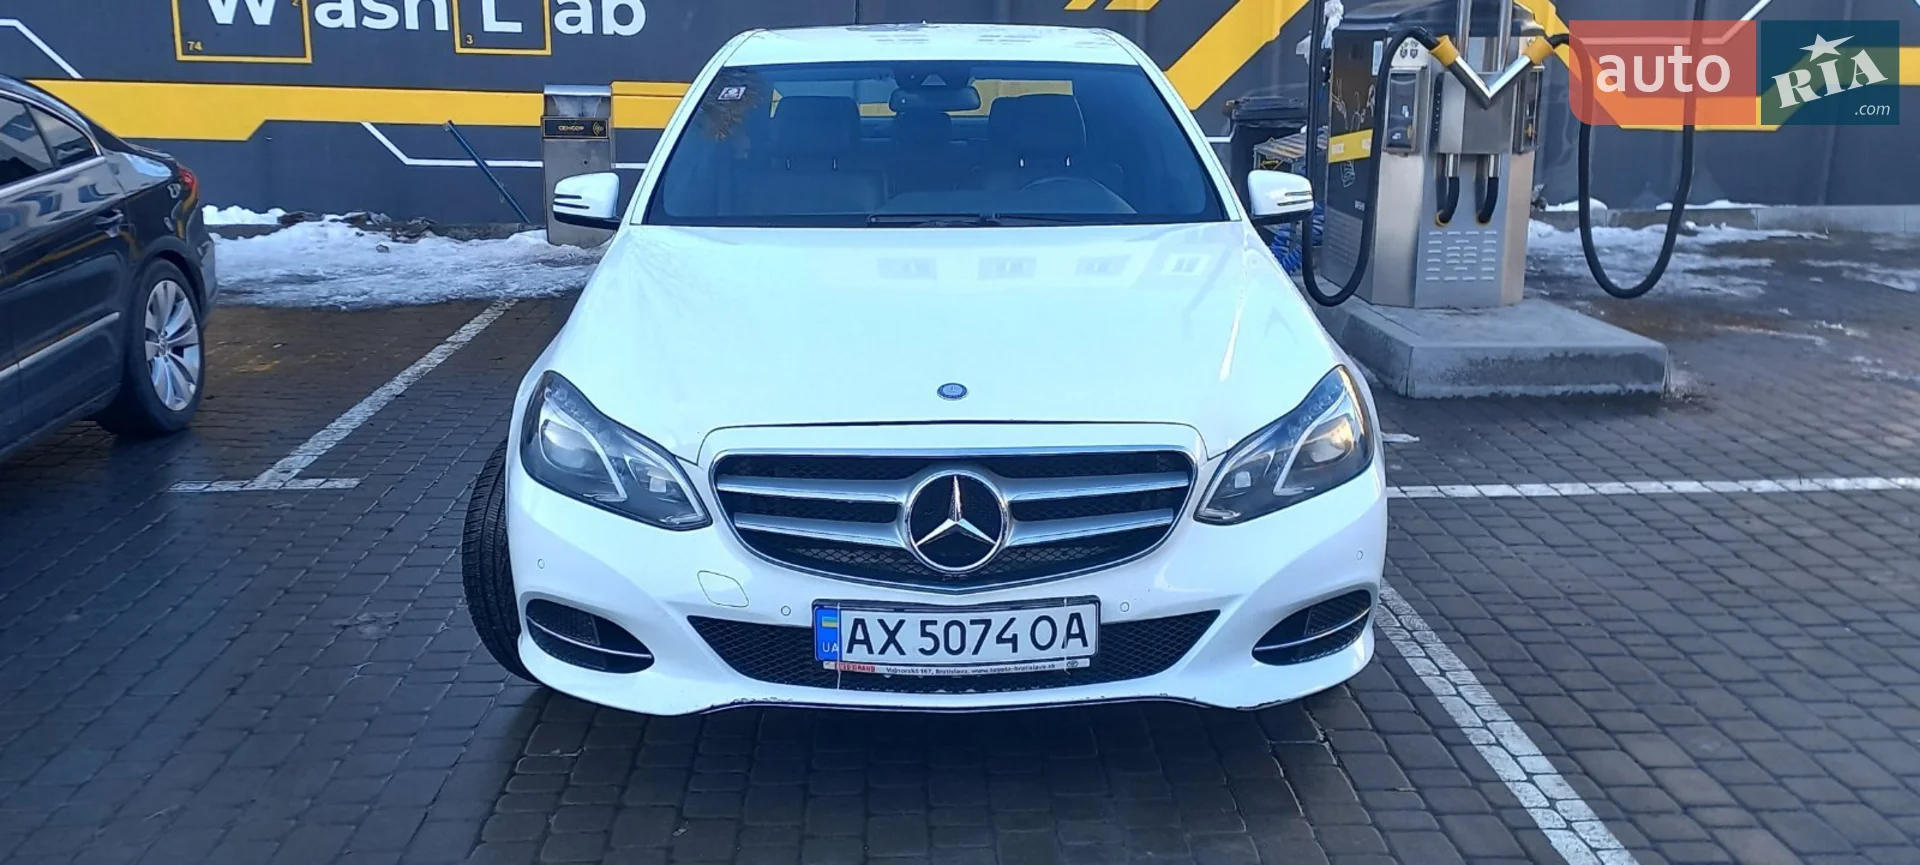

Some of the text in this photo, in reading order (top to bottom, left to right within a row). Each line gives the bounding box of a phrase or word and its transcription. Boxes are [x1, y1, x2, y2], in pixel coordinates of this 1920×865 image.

[482, 0, 646, 36] Lab
[465, 34, 474, 45] 3
[187, 41, 203, 51] 74
[846, 612, 1089, 656] AX 5074 OA
[822, 643, 838, 653] UA
